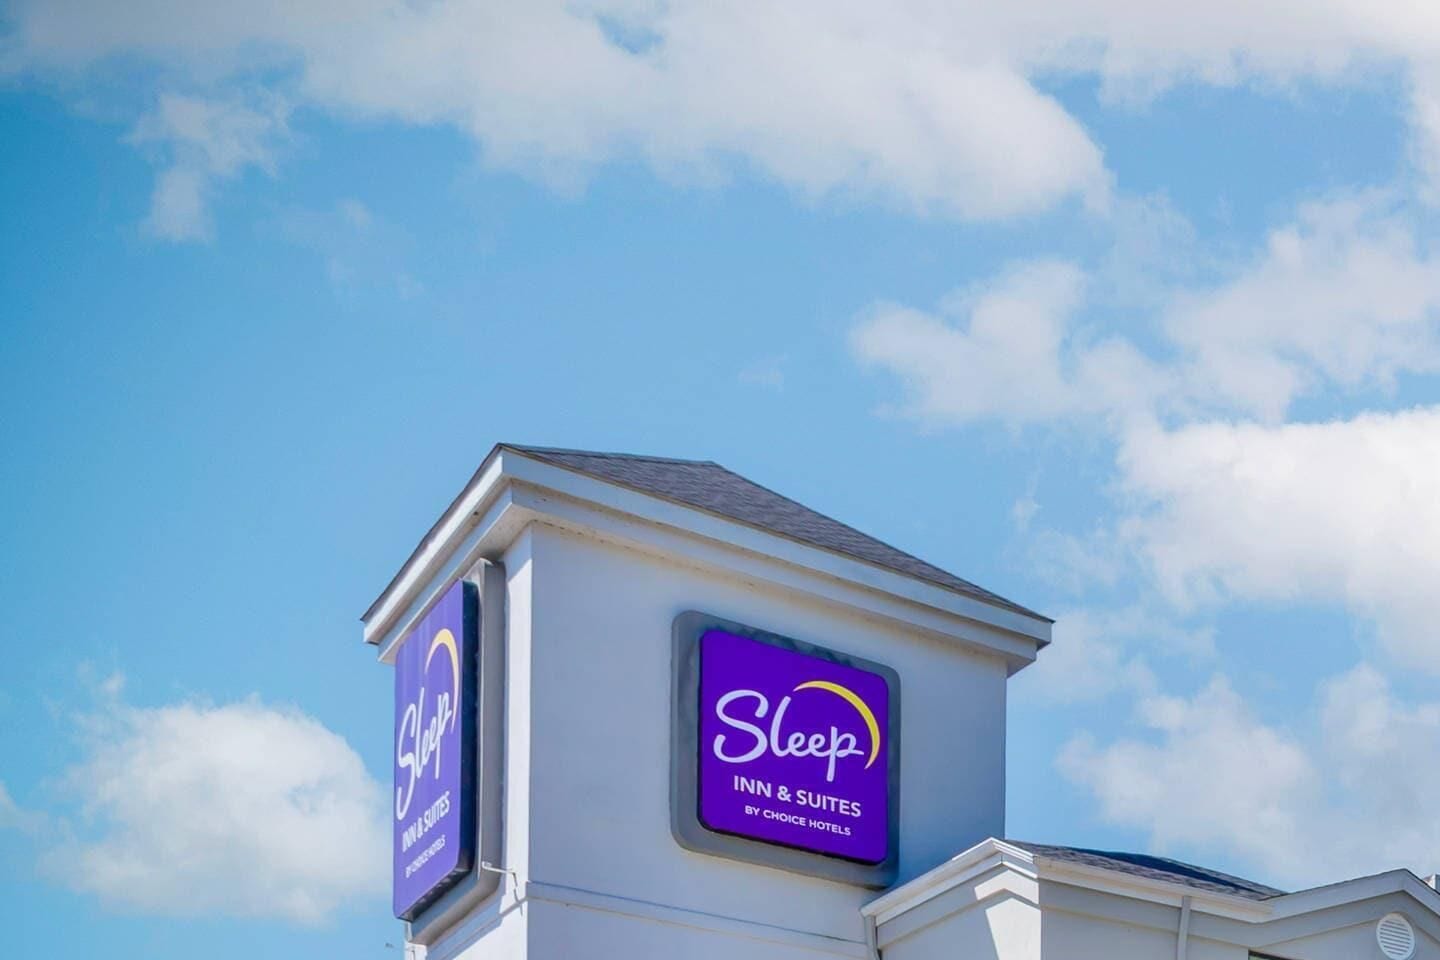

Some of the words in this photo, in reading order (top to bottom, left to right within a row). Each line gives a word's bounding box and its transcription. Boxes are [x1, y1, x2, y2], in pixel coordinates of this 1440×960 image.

[396, 687, 452, 820] Sleep
[713, 689, 865, 782] Sleep
[424, 791, 450, 832] SUITES
[733, 775, 772, 798] INN
[777, 785, 792, 803] &
[796, 789, 862, 818] SUITES
[744, 805, 760, 816] BY
[763, 809, 806, 827] CHOICE
[809, 819, 851, 836] HOTELS
